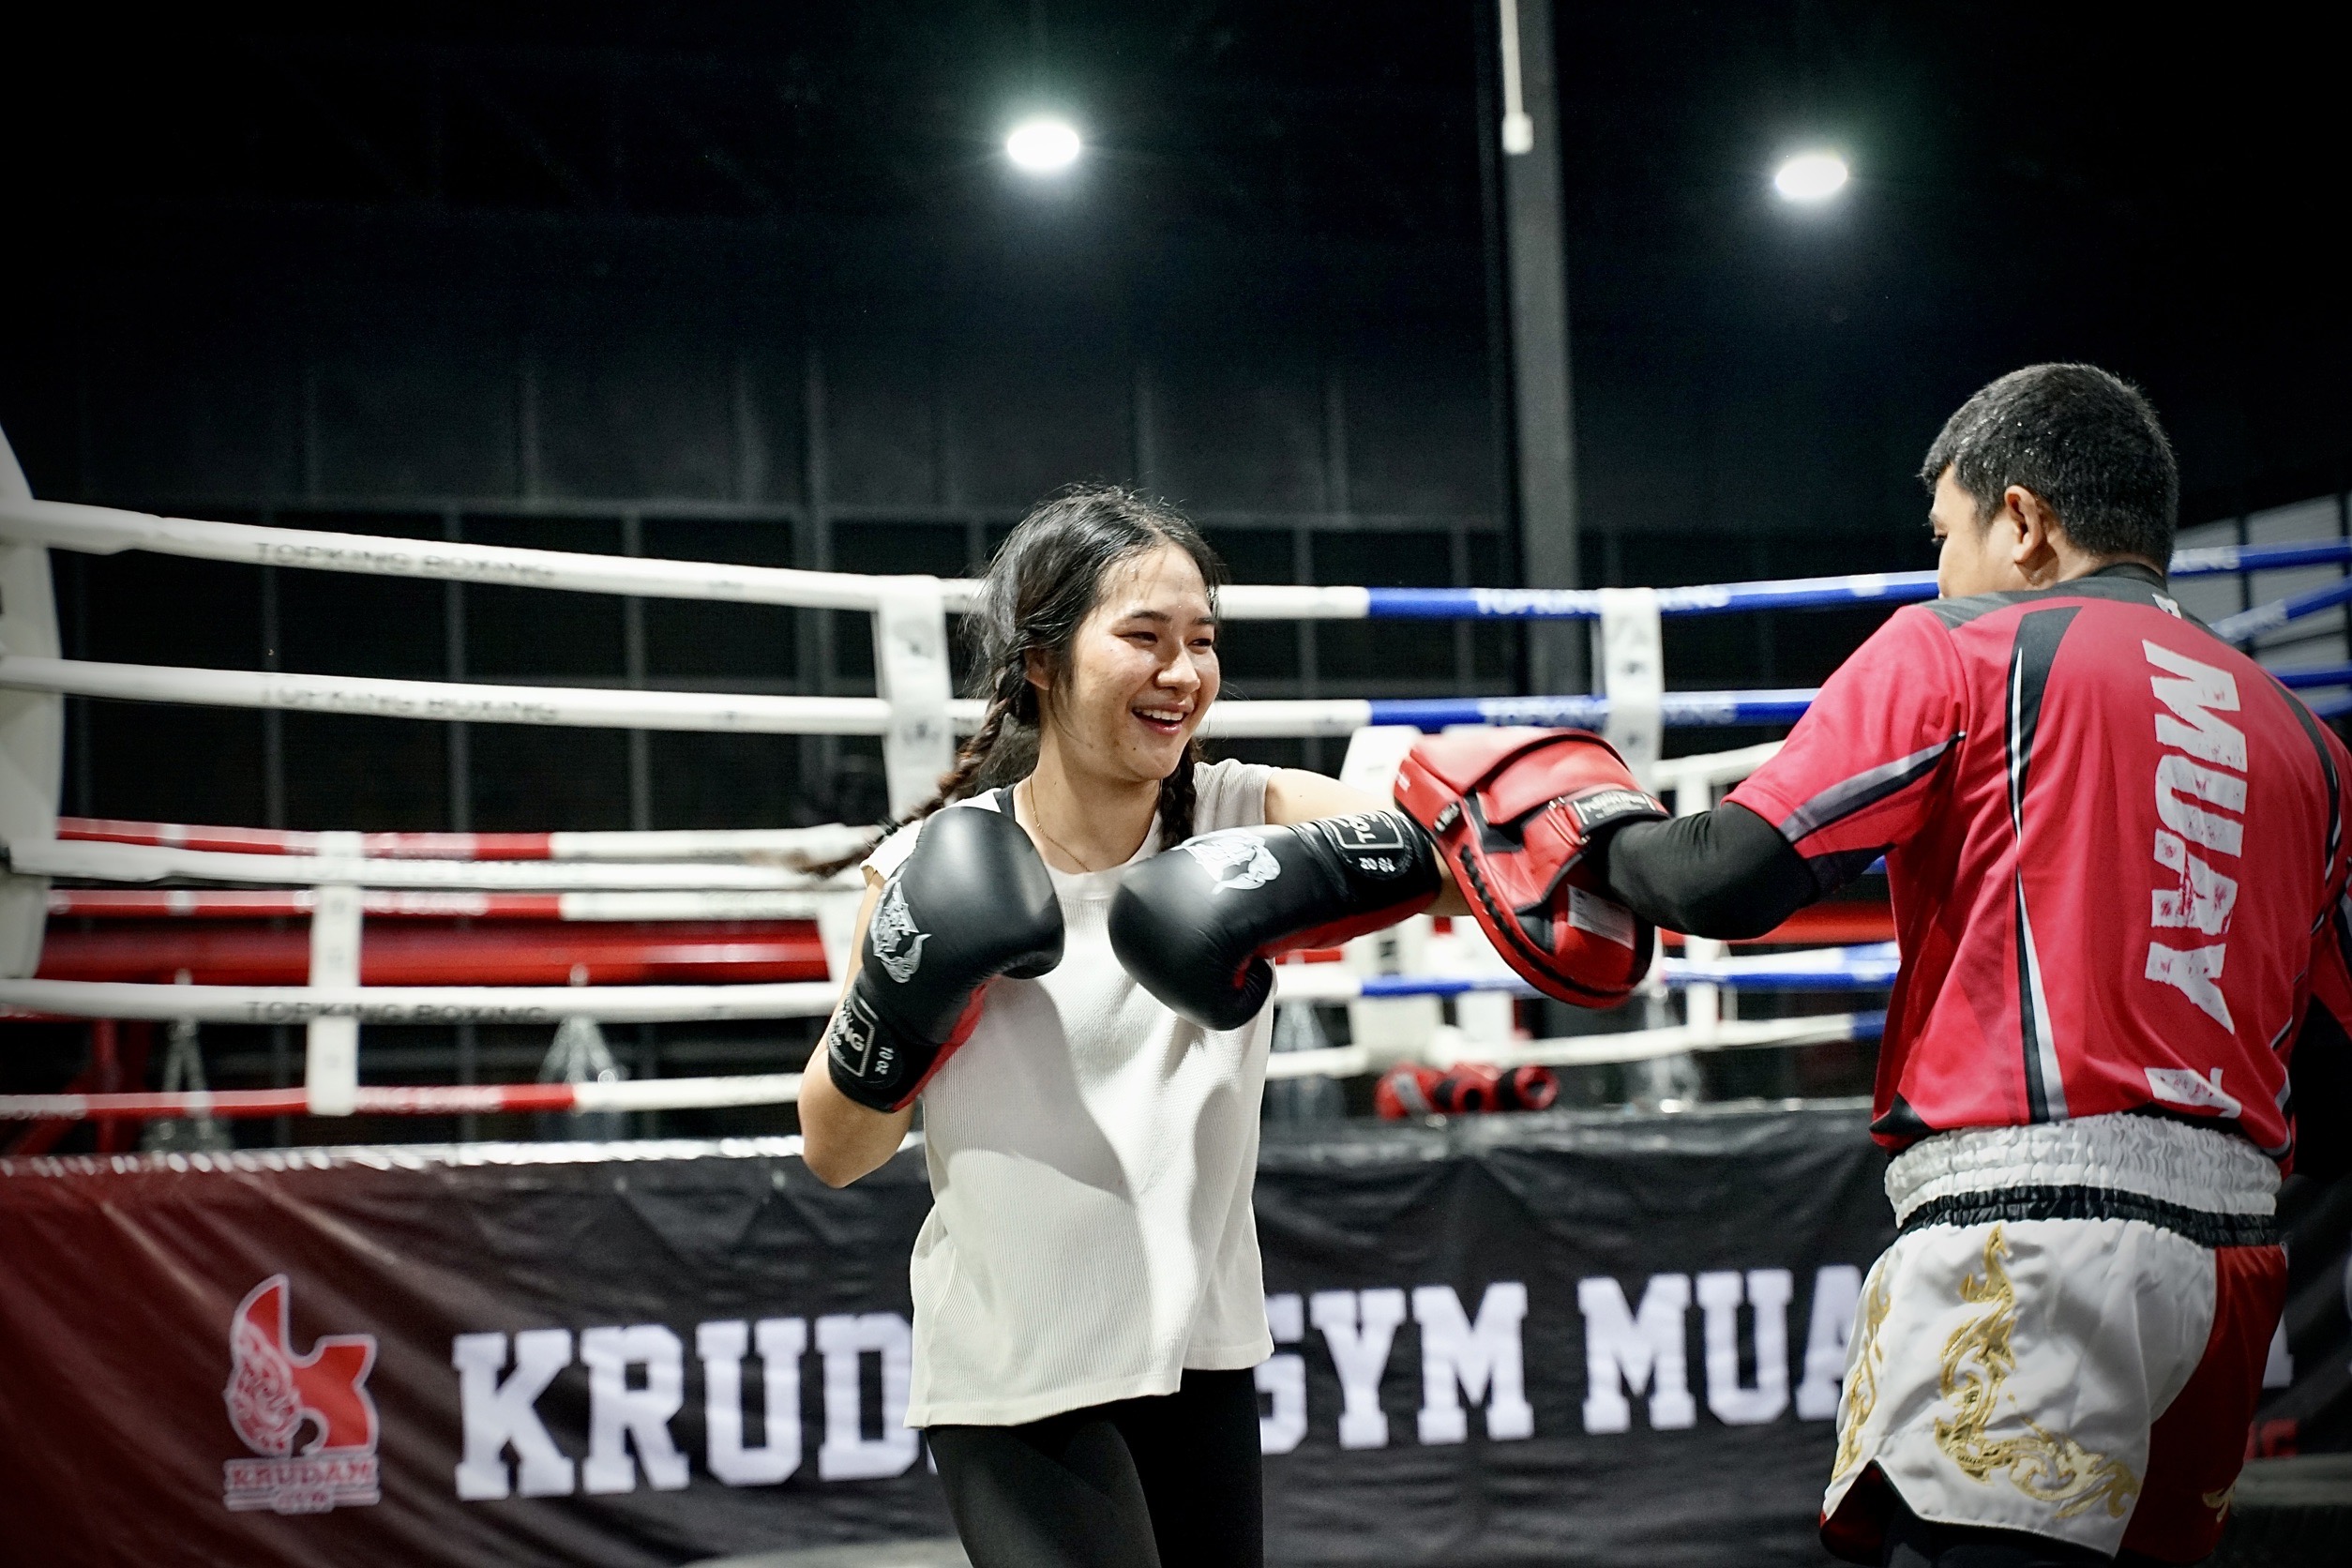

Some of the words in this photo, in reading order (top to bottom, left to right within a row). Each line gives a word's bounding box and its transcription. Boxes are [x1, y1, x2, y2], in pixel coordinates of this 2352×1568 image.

[2142, 639, 2248, 1035] MUAY
[451, 1312, 938, 1500] KRUD
[1577, 1264, 1862, 1434] MUA
